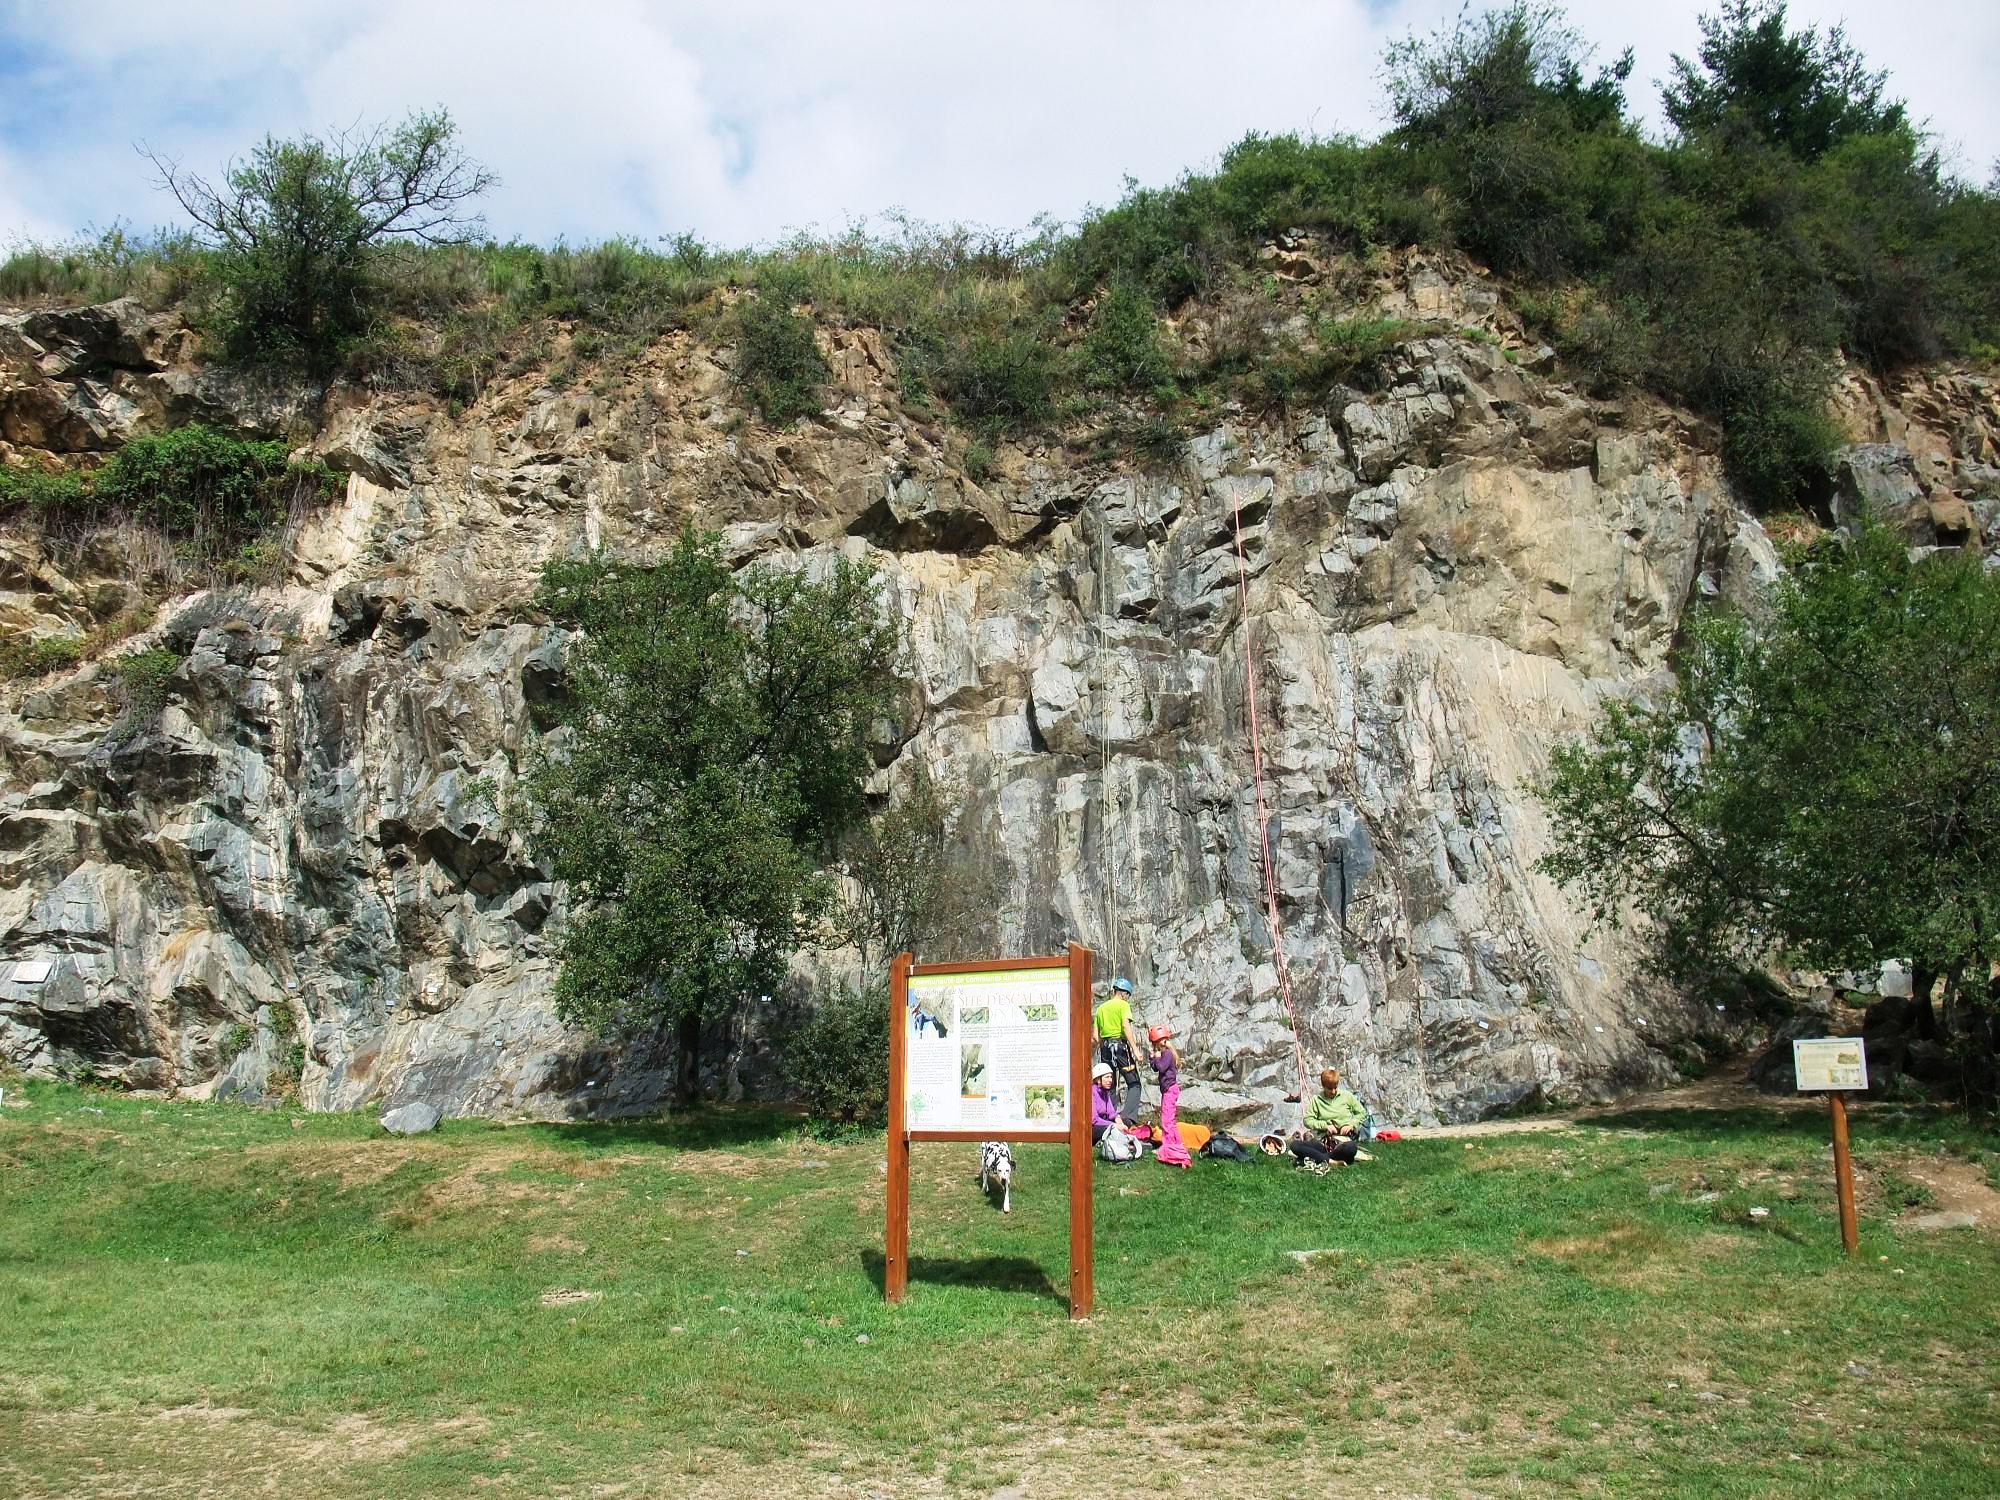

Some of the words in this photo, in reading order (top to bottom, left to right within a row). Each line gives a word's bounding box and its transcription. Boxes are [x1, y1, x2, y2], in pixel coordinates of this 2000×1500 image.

[912, 977, 954, 986] Communauté
[956, 976, 964, 984] de
[965, 975, 1002, 983] Communes
